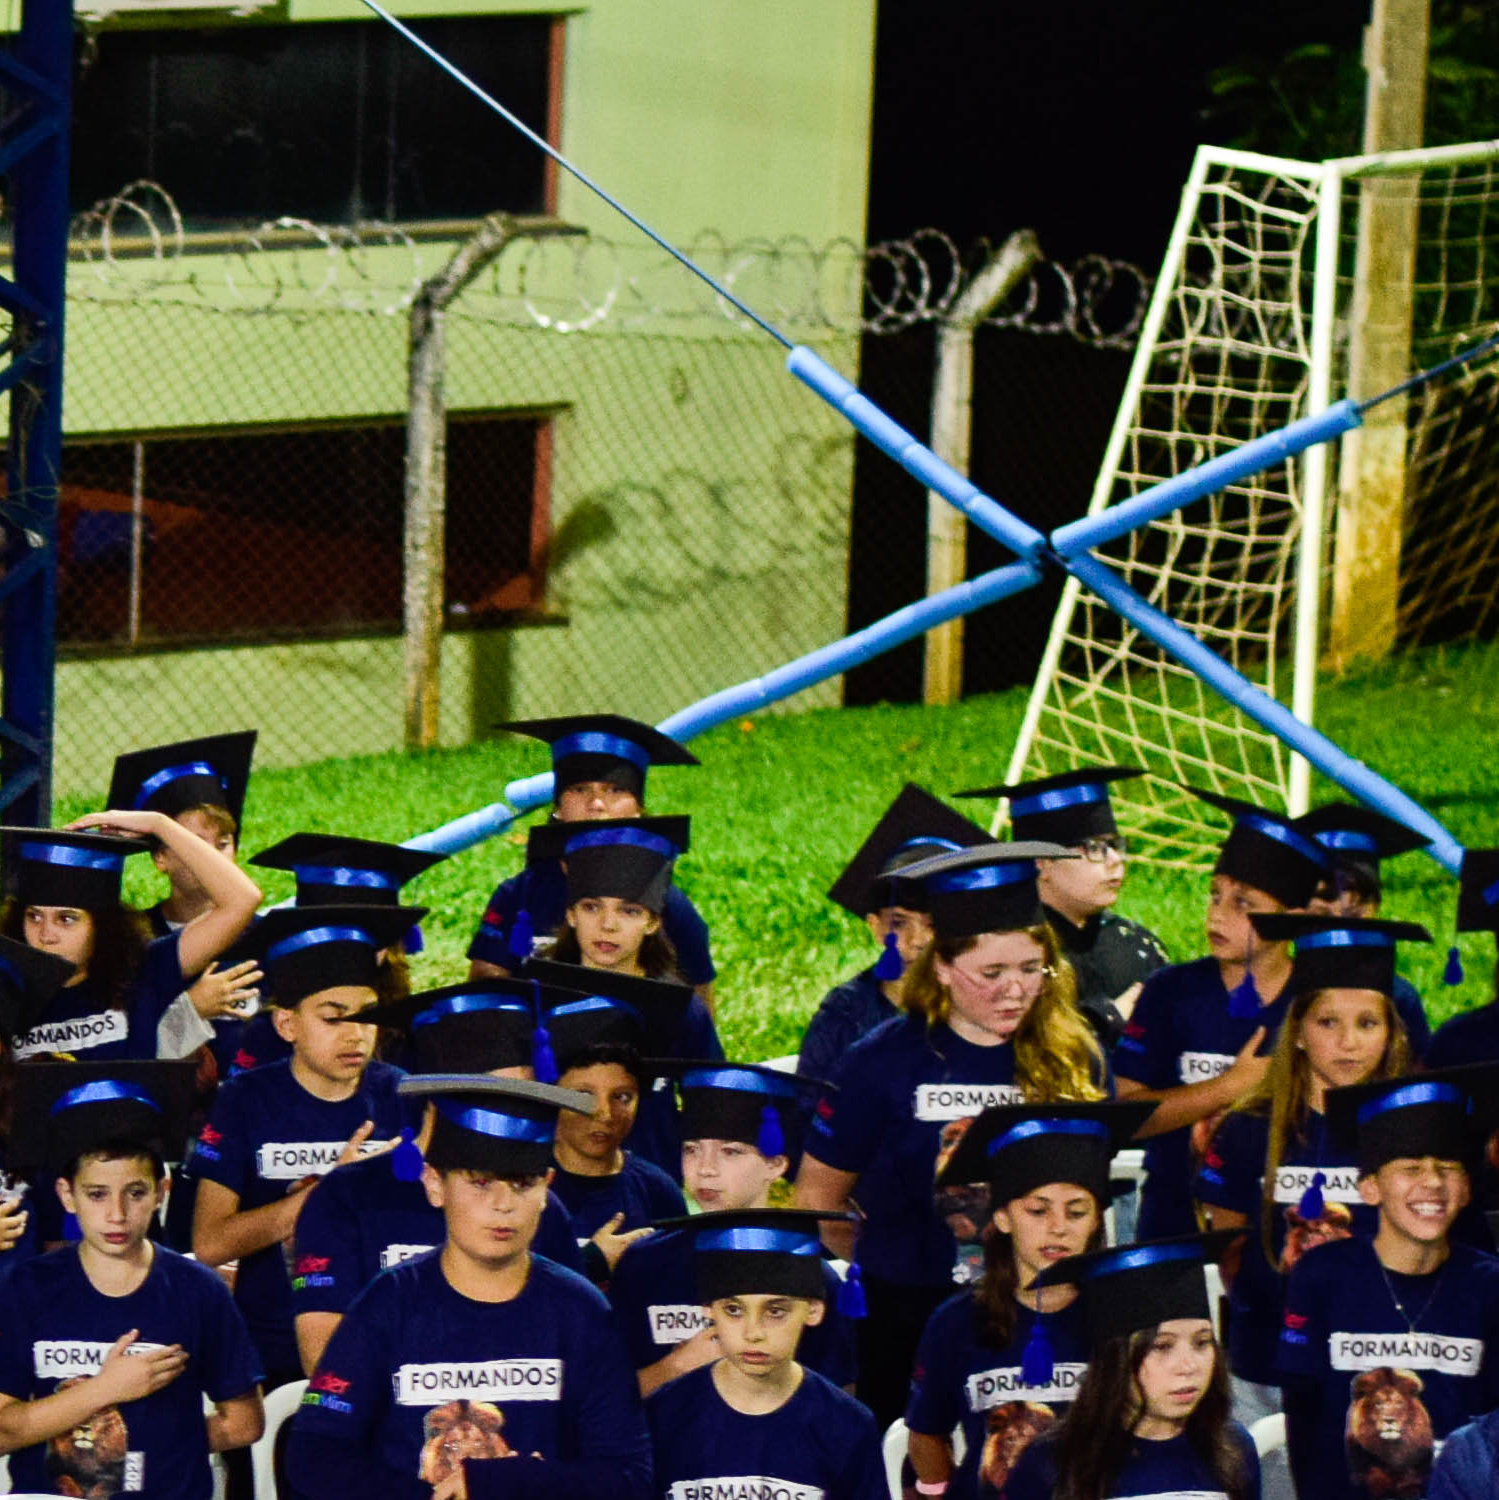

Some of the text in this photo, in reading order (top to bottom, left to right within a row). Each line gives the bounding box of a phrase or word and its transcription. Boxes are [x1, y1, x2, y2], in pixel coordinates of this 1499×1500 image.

[12, 1015, 115, 1049] ORMANDOS
[411, 1367, 558, 1390] FORMANDOS
[123, 1452, 144, 1491] 2024
